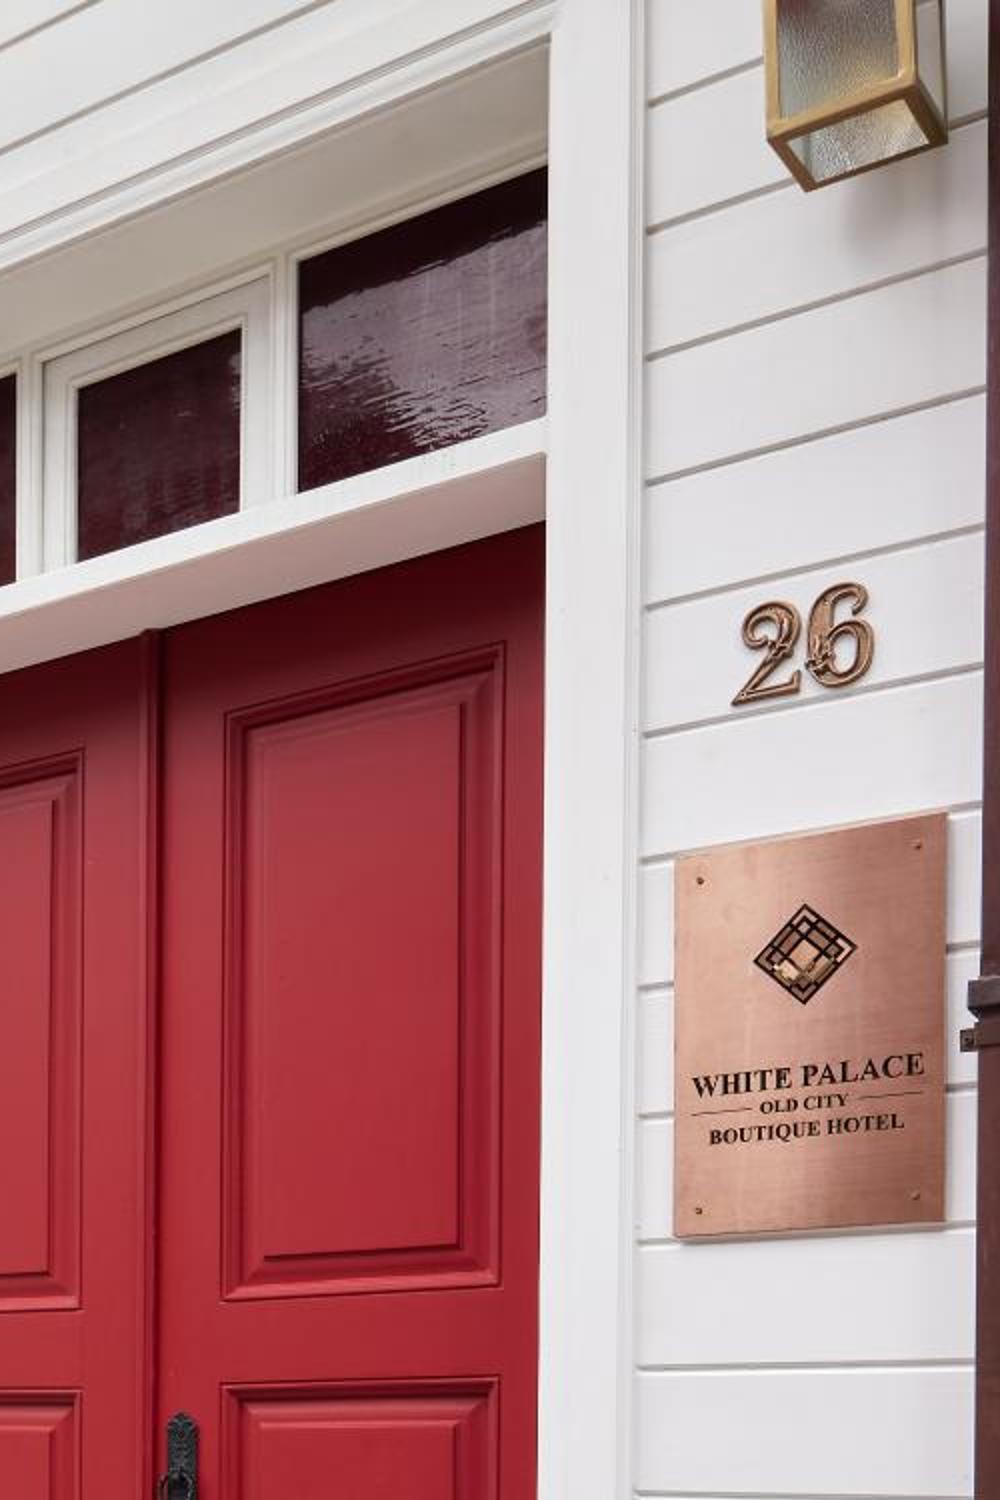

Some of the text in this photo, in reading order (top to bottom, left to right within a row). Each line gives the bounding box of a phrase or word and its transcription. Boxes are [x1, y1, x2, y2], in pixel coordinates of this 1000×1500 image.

[731, 582, 875, 707] 26
[691, 1052, 926, 1099] WHITE PALACE
[759, 1093, 850, 1115] OLD CITY
[709, 1112, 905, 1146] BOUTIQUE HOTEL
